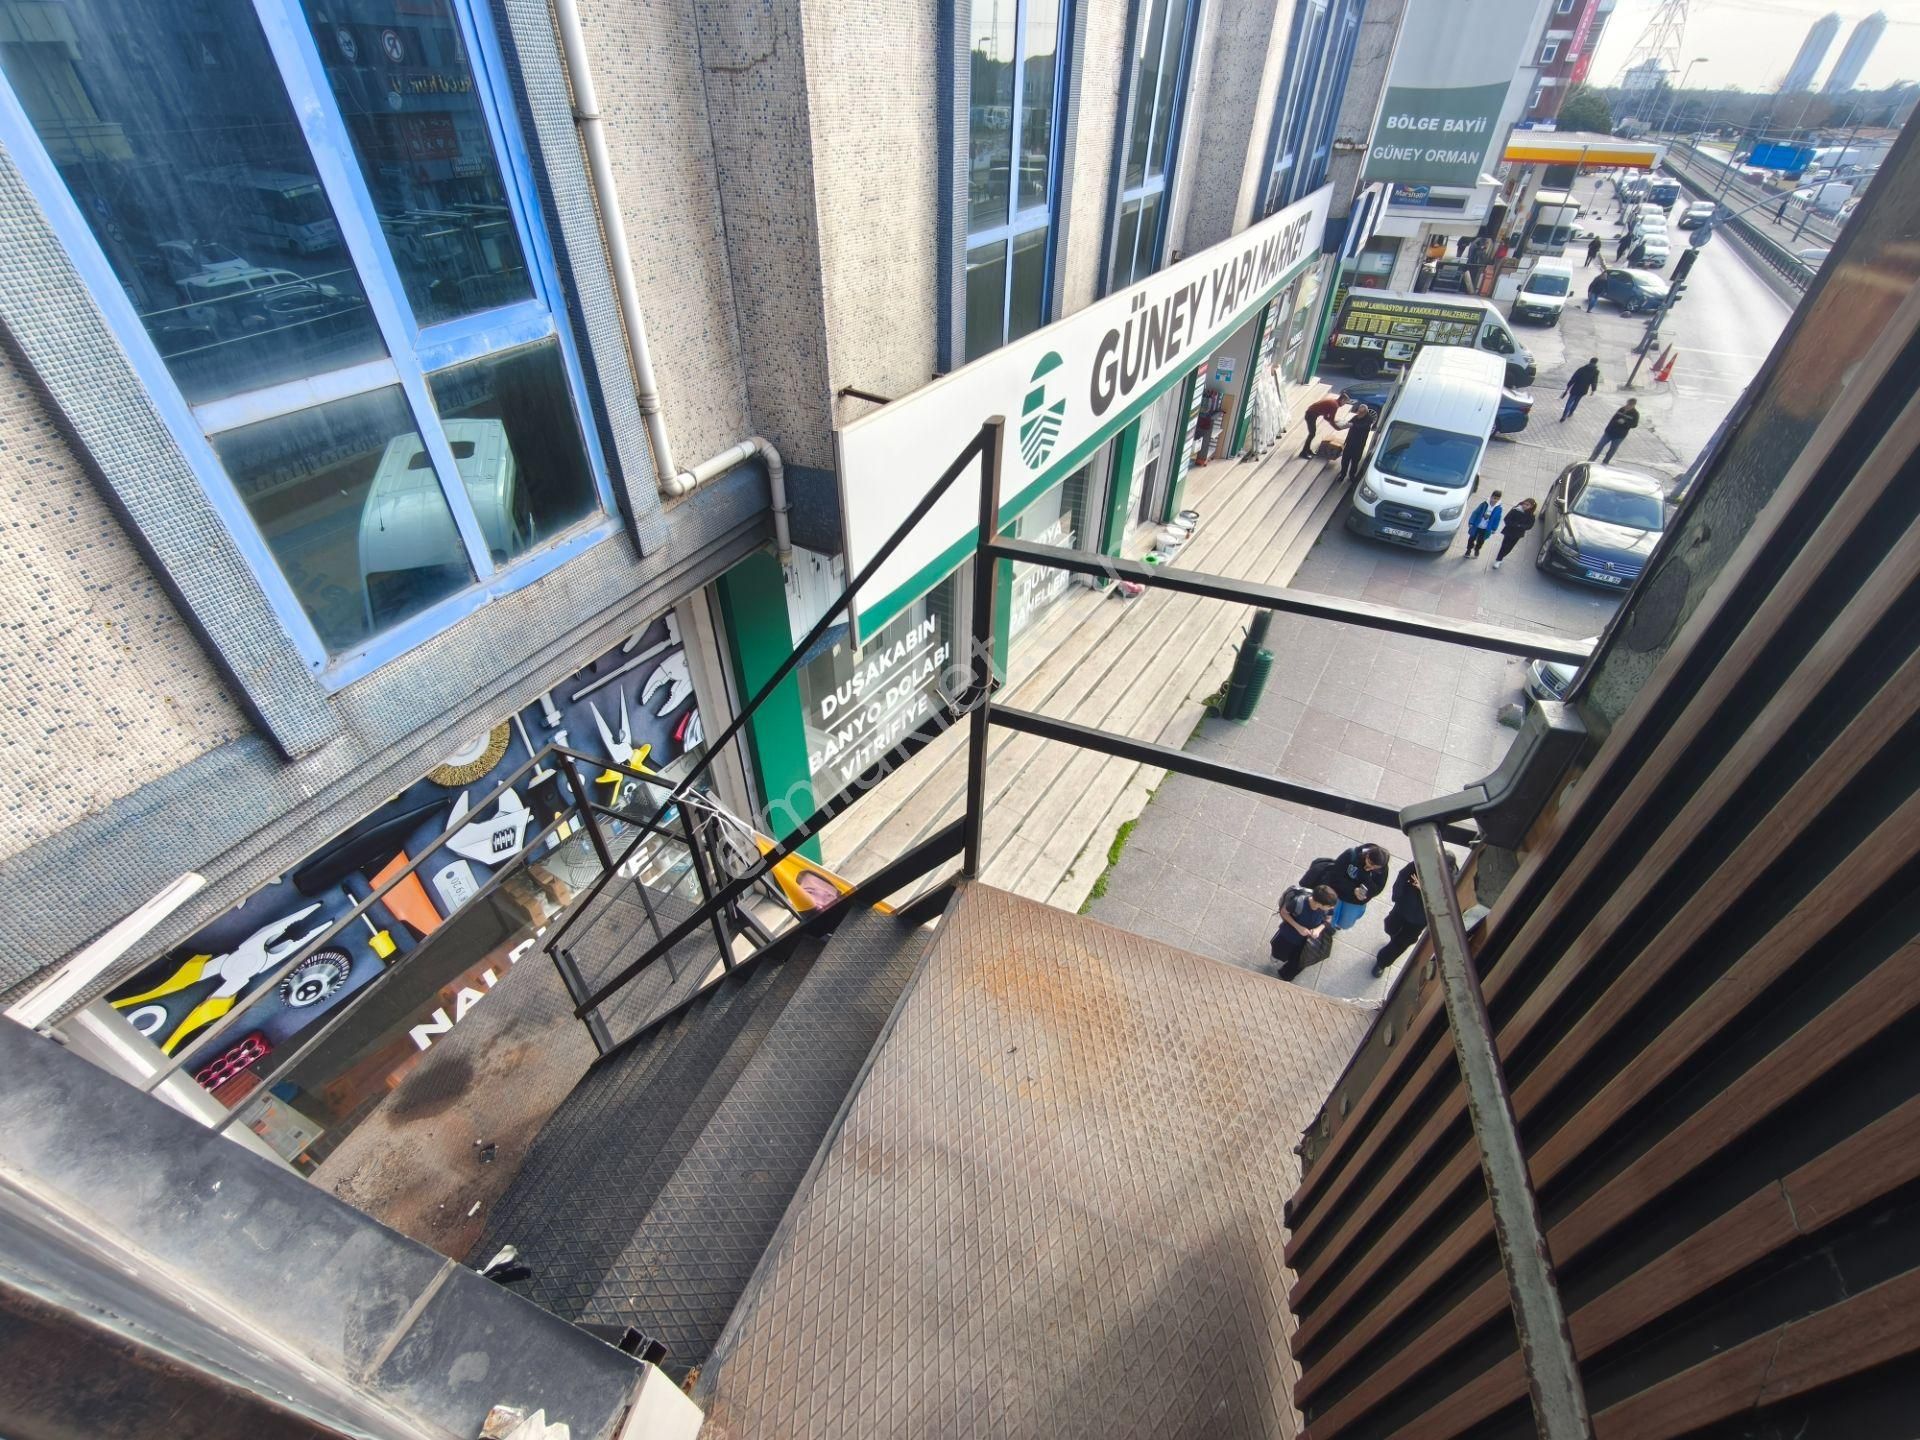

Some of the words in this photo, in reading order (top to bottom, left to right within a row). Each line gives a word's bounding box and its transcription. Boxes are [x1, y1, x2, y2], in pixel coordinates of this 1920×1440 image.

[1373, 144, 1423, 161] GÜNEY
[1425, 149, 1480, 165] ORMAN
[1386, 114, 1440, 131] BÖLGE
[1090, 276, 1207, 417] GÜNEY
[1208, 245, 1259, 330] YAPI
[1260, 210, 1313, 288] MARKET
[808, 701, 881, 777] BANYO
[885, 641, 950, 710] DOLABI
[821, 613, 936, 720] DUŞAKABIN
